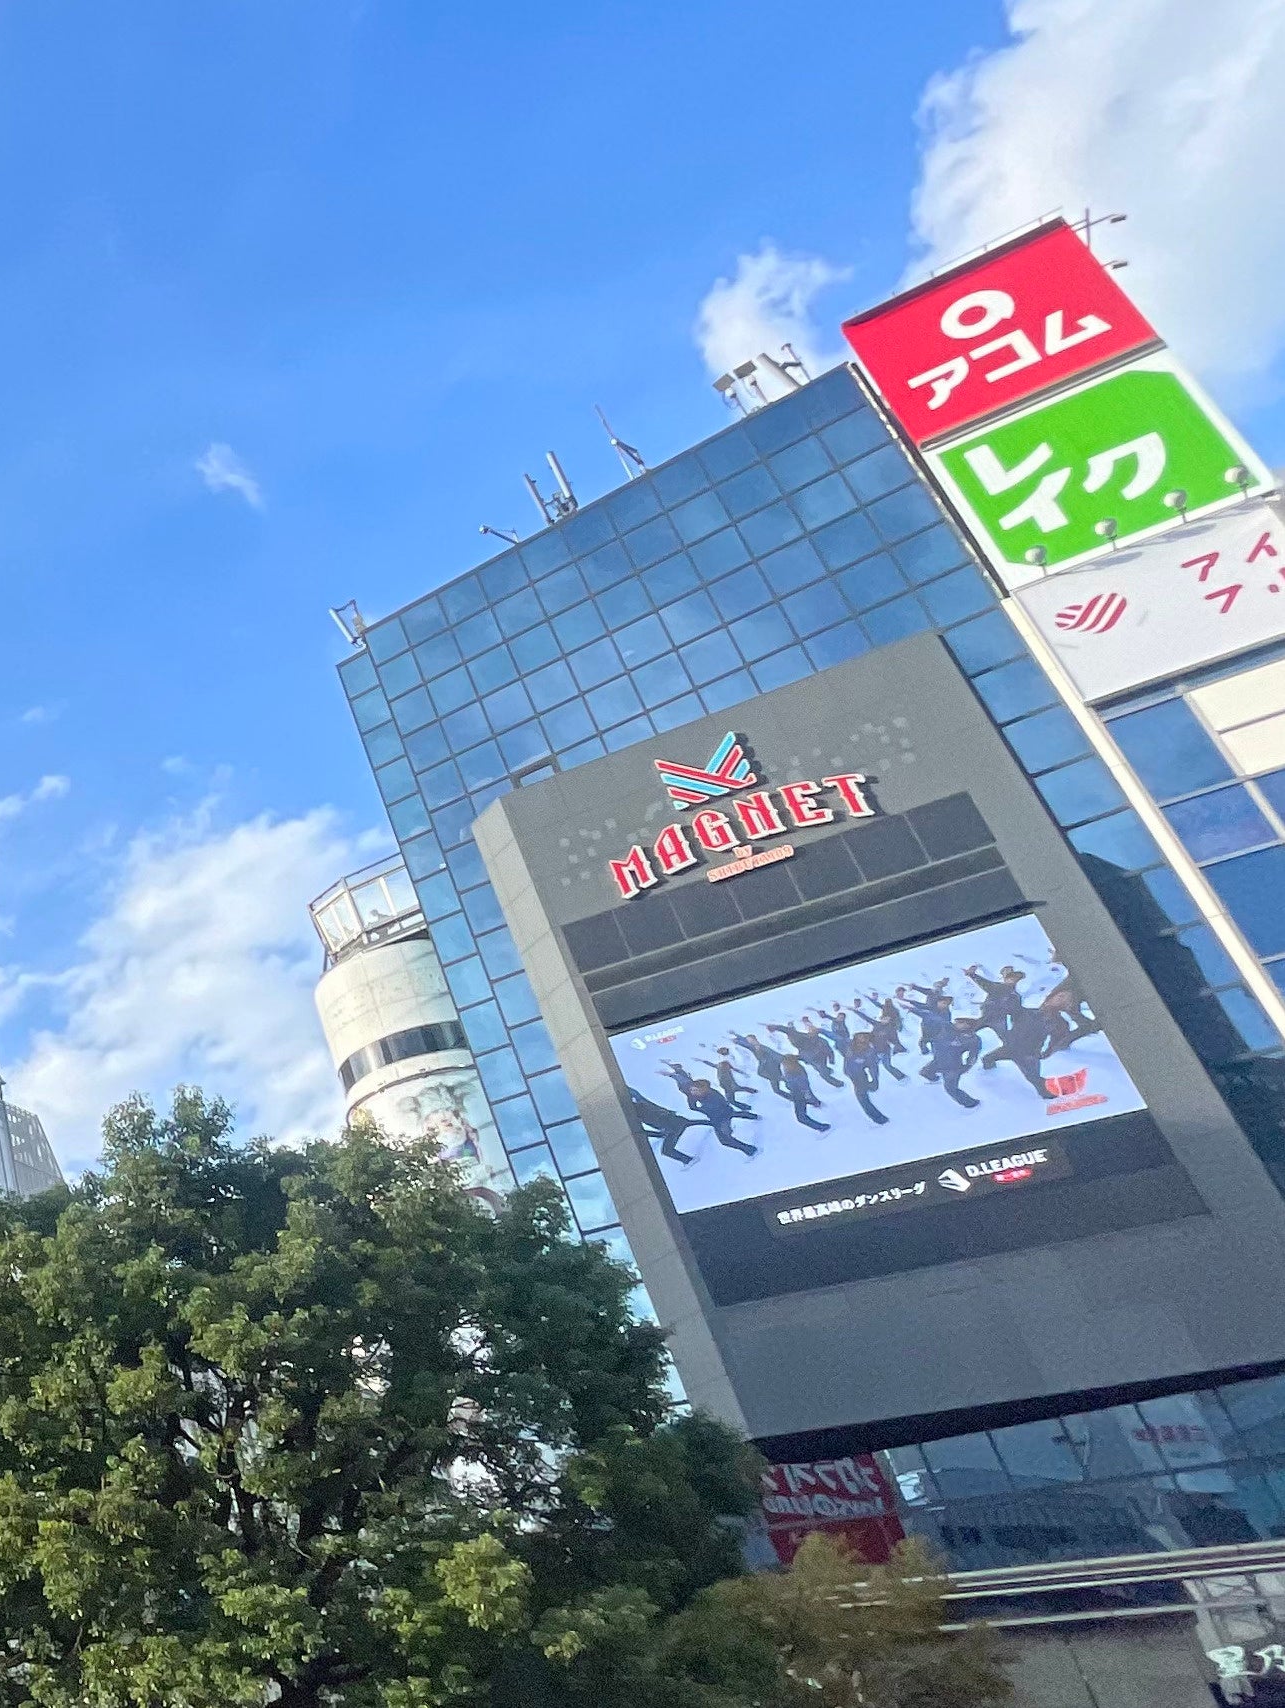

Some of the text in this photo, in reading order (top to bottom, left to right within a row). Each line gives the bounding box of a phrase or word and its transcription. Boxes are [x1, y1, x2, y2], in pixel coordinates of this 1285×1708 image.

[907, 309, 1113, 411] アコム
[963, 431, 1168, 533] レイク
[608, 773, 876, 900] MAGNET
[964, 1149, 1048, 1178] D.LEAGUE
